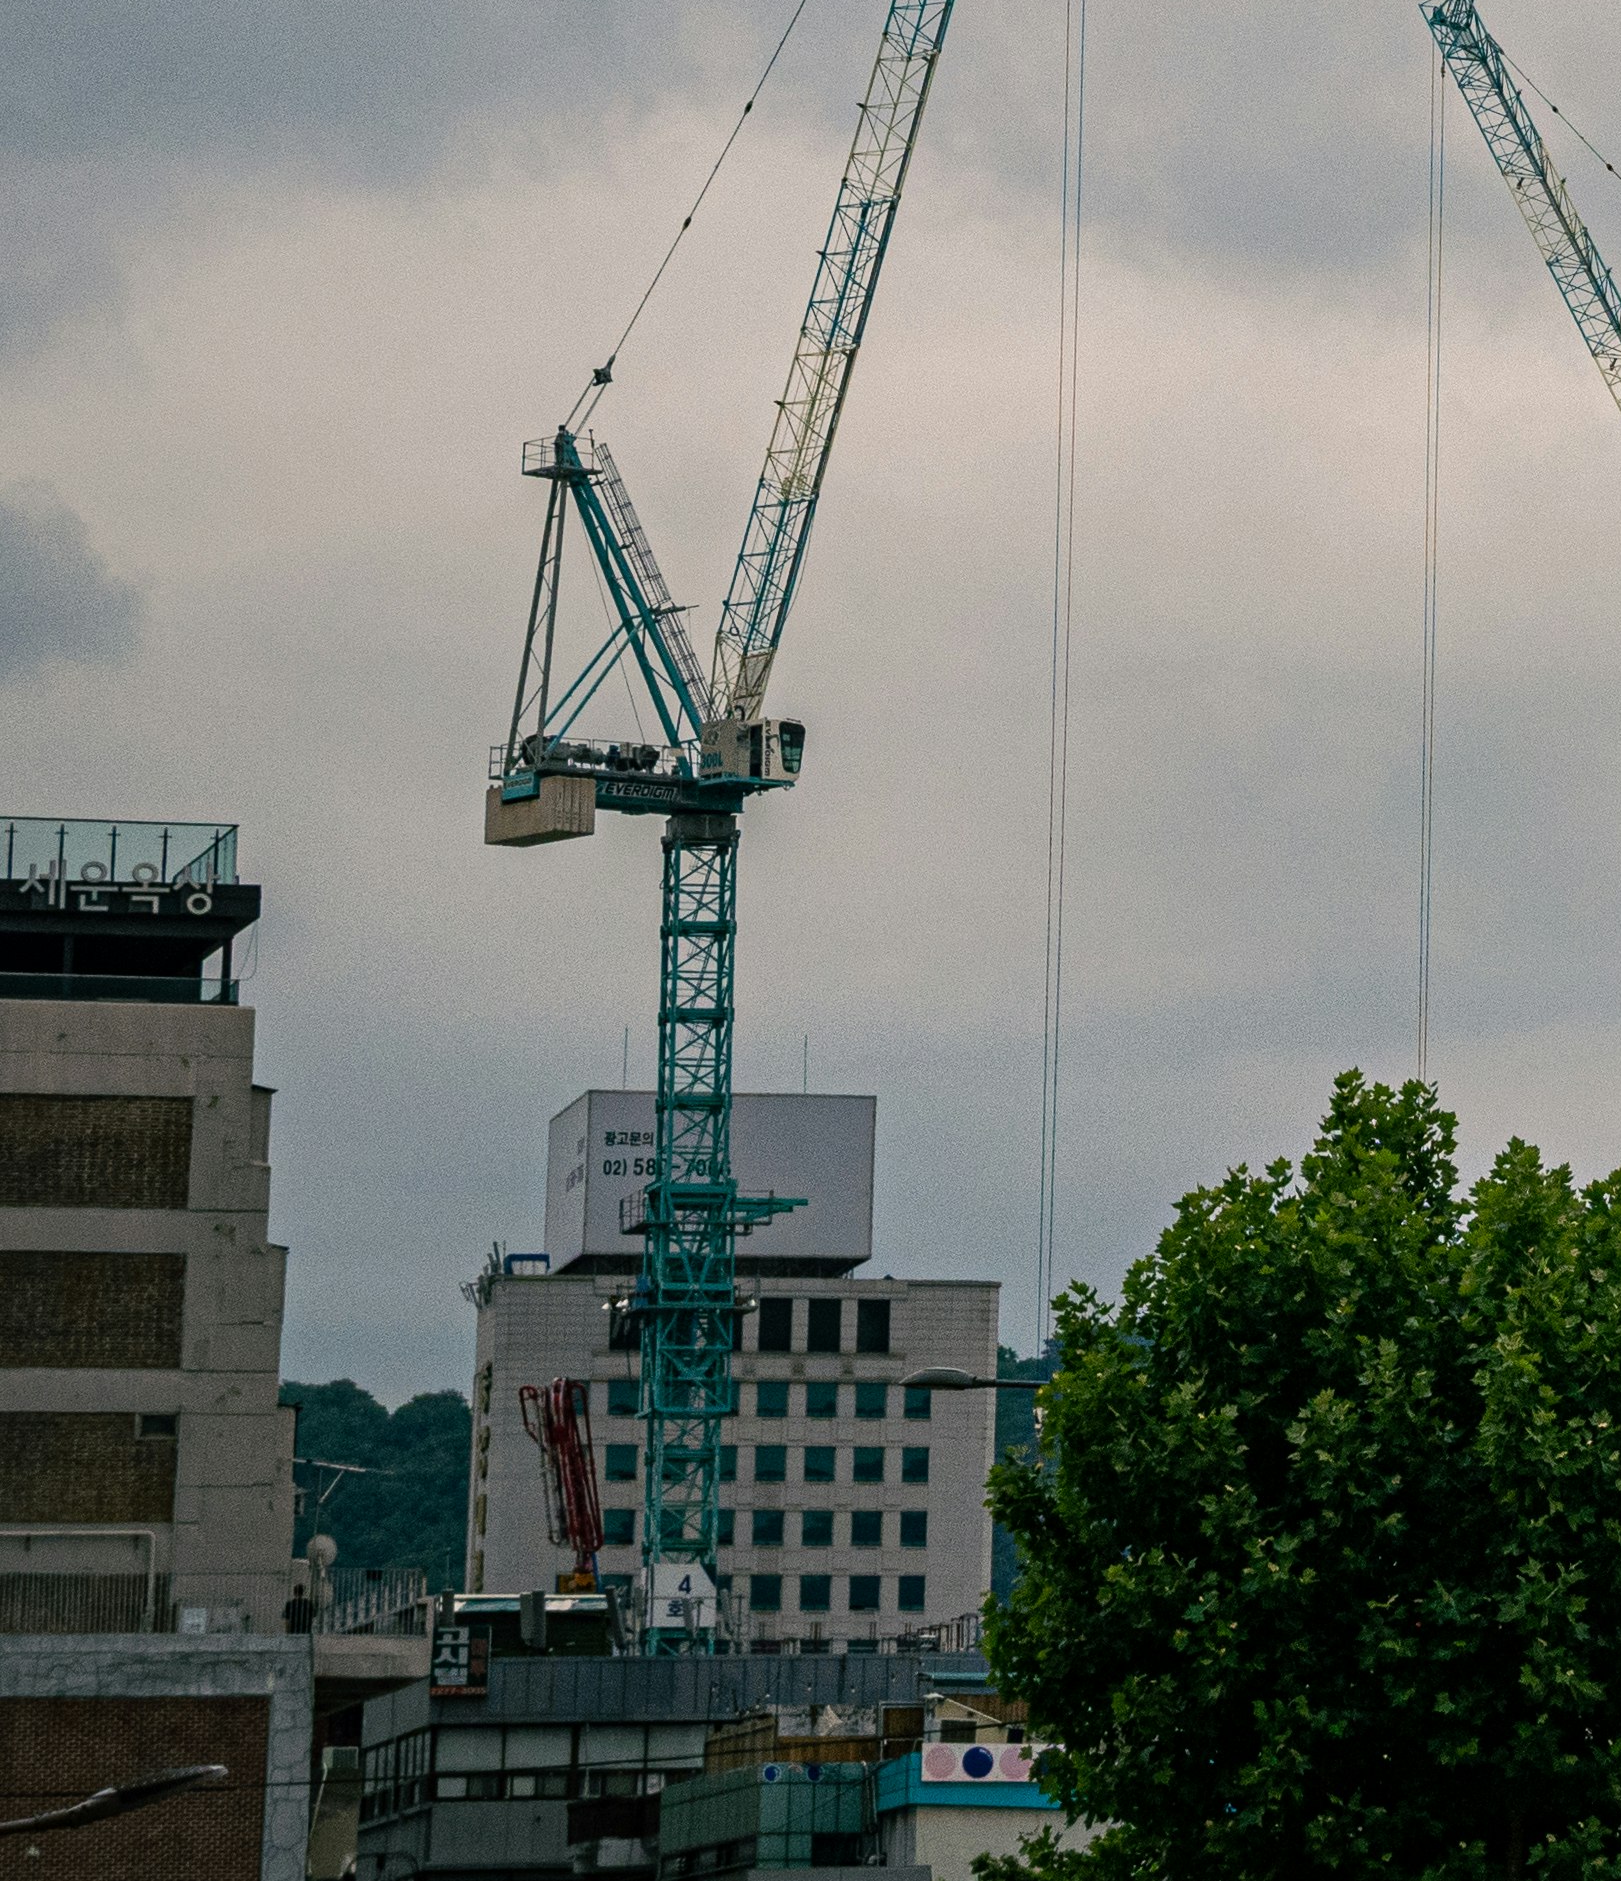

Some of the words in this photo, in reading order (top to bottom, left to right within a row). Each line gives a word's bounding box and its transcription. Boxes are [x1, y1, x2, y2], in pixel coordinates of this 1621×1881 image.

[605, 782, 676, 799] EVERDIGM
[19, 858, 221, 915] 세운옥상
[604, 1131, 654, 1147] 광고문의
[603, 1159, 627, 1177] 02)
[678, 1574, 692, 1594] 4
